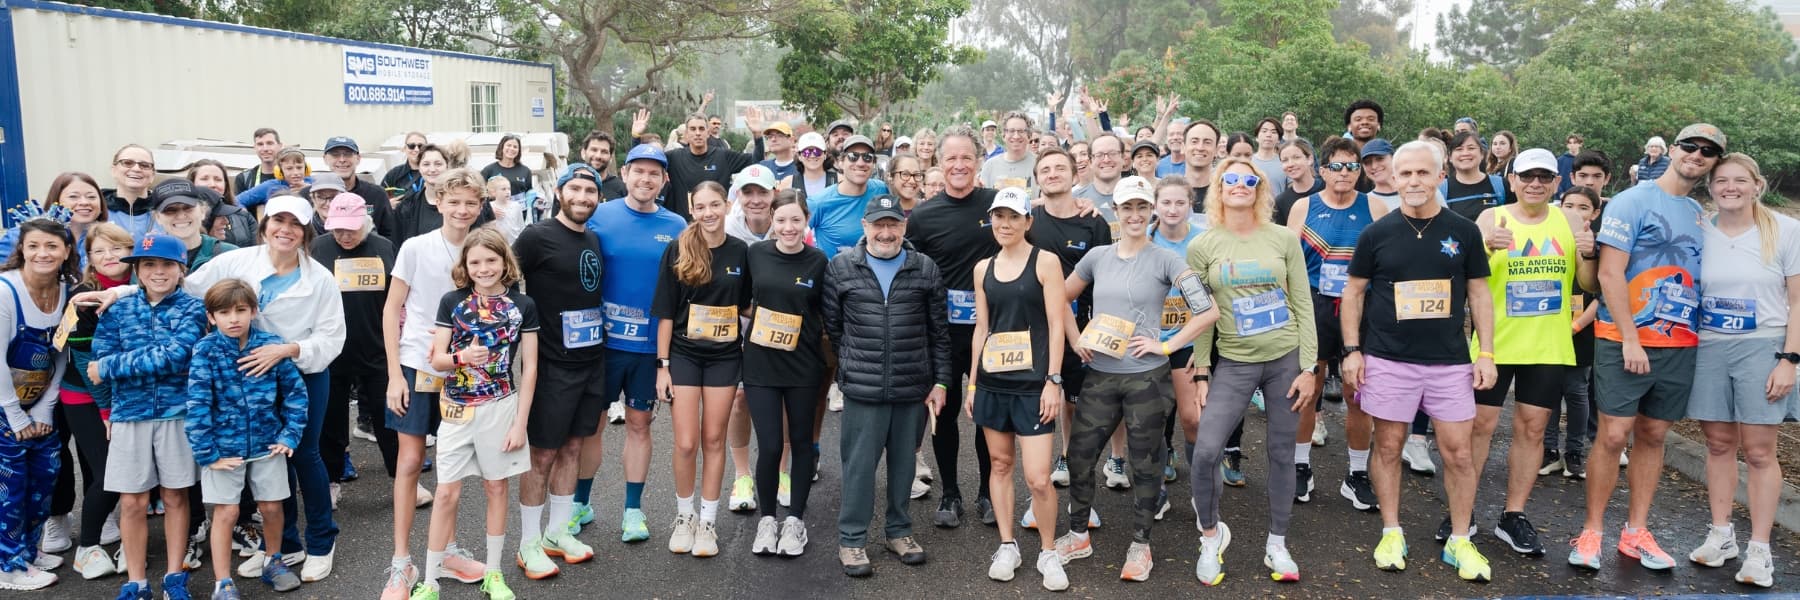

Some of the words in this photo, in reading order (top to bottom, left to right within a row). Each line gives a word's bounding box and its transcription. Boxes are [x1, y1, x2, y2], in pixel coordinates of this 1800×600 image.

[347, 55, 375, 73] SMS
[377, 55, 430, 69] SOUTHWEST
[348, 86, 405, 102] 800.686.9114
[1508, 260, 1524, 268] LOS
[1508, 265, 1567, 275] MARATHON
[358, 274, 379, 286] 183
[1420, 299, 1445, 313] 124
[1538, 298, 1549, 311] 6
[1269, 310, 1276, 325] 1
[1722, 316, 1744, 330] 20
[590, 326, 600, 341] 14
[623, 323, 639, 337] 13
[713, 324, 730, 337] 115
[770, 330, 794, 345] 130
[1096, 332, 1122, 351] 146
[1000, 351, 1025, 366] 144
[22, 386, 46, 400] 15
